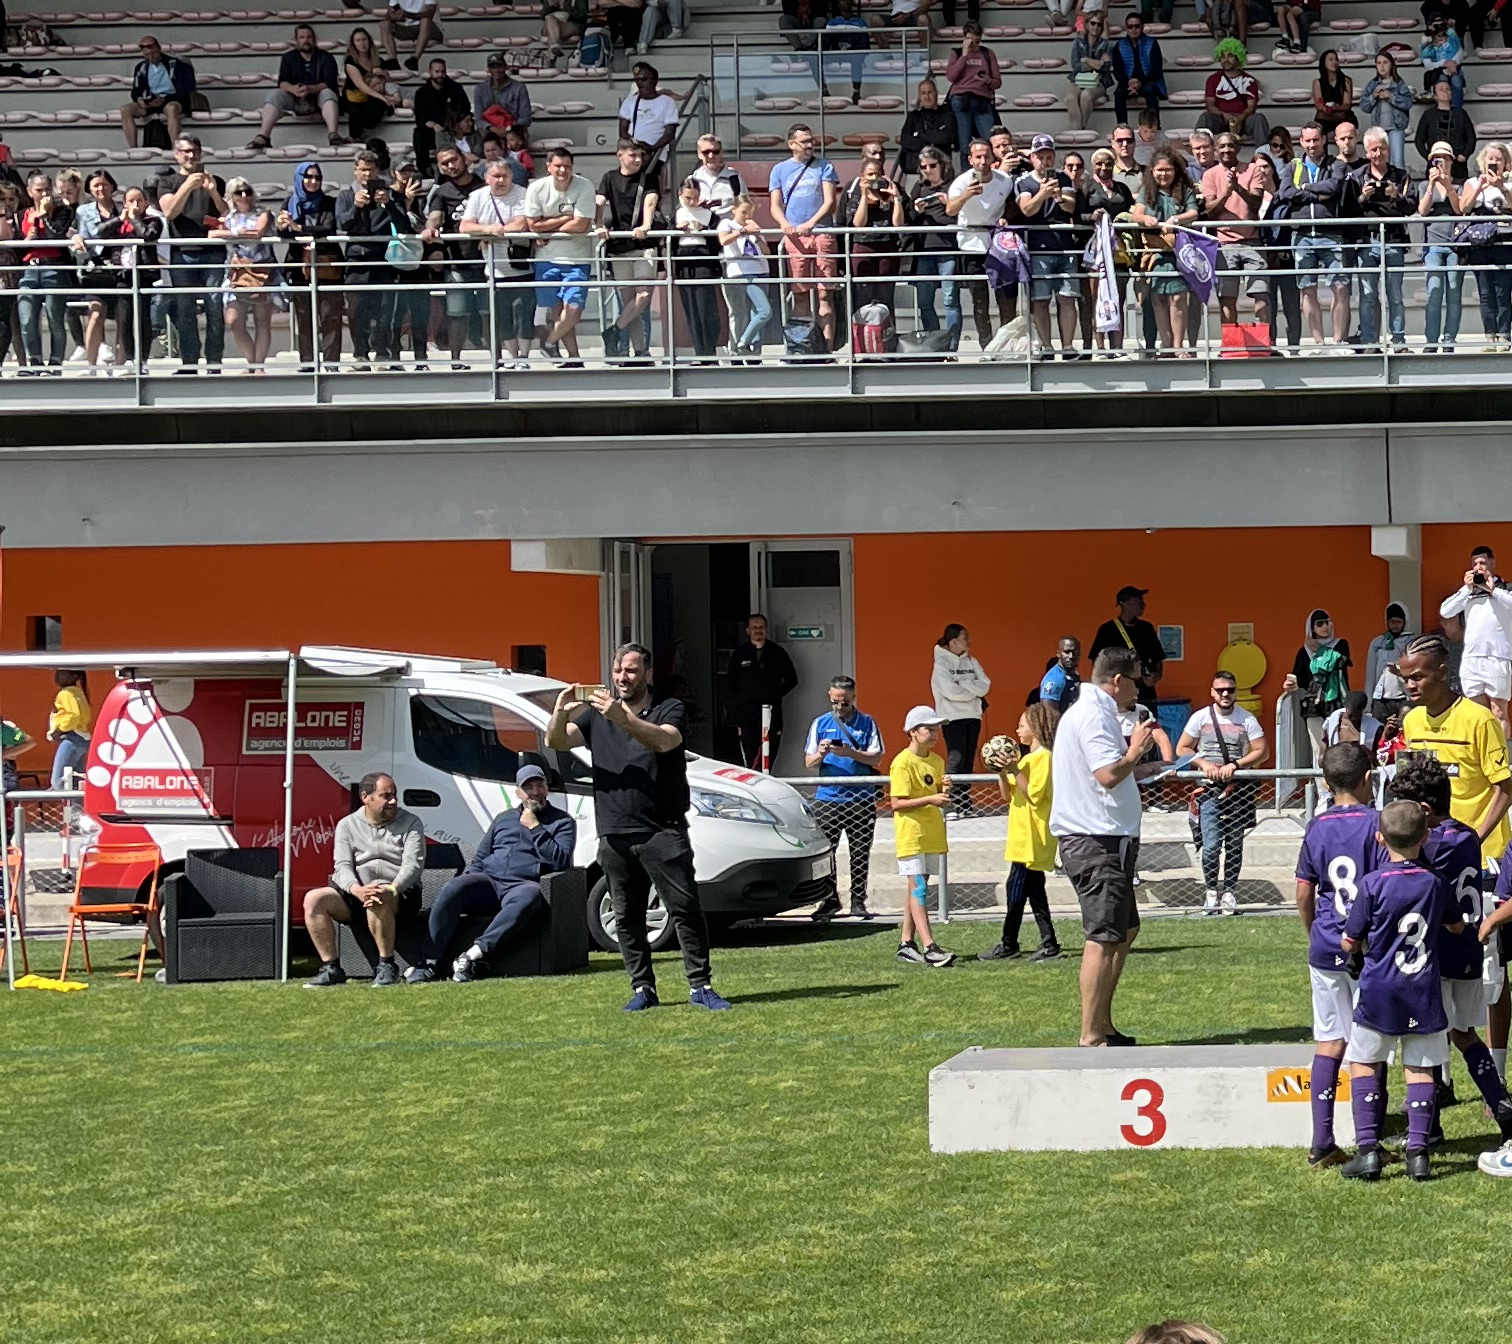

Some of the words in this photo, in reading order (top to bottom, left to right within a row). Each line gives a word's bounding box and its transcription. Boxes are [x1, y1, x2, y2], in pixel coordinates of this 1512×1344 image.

[595, 134, 607, 145] G
[121, 775, 199, 790] ABALONE
[1328, 856, 1359, 918] 8
[1394, 912, 1430, 976] 3
[1120, 1078, 1167, 1147] 3
